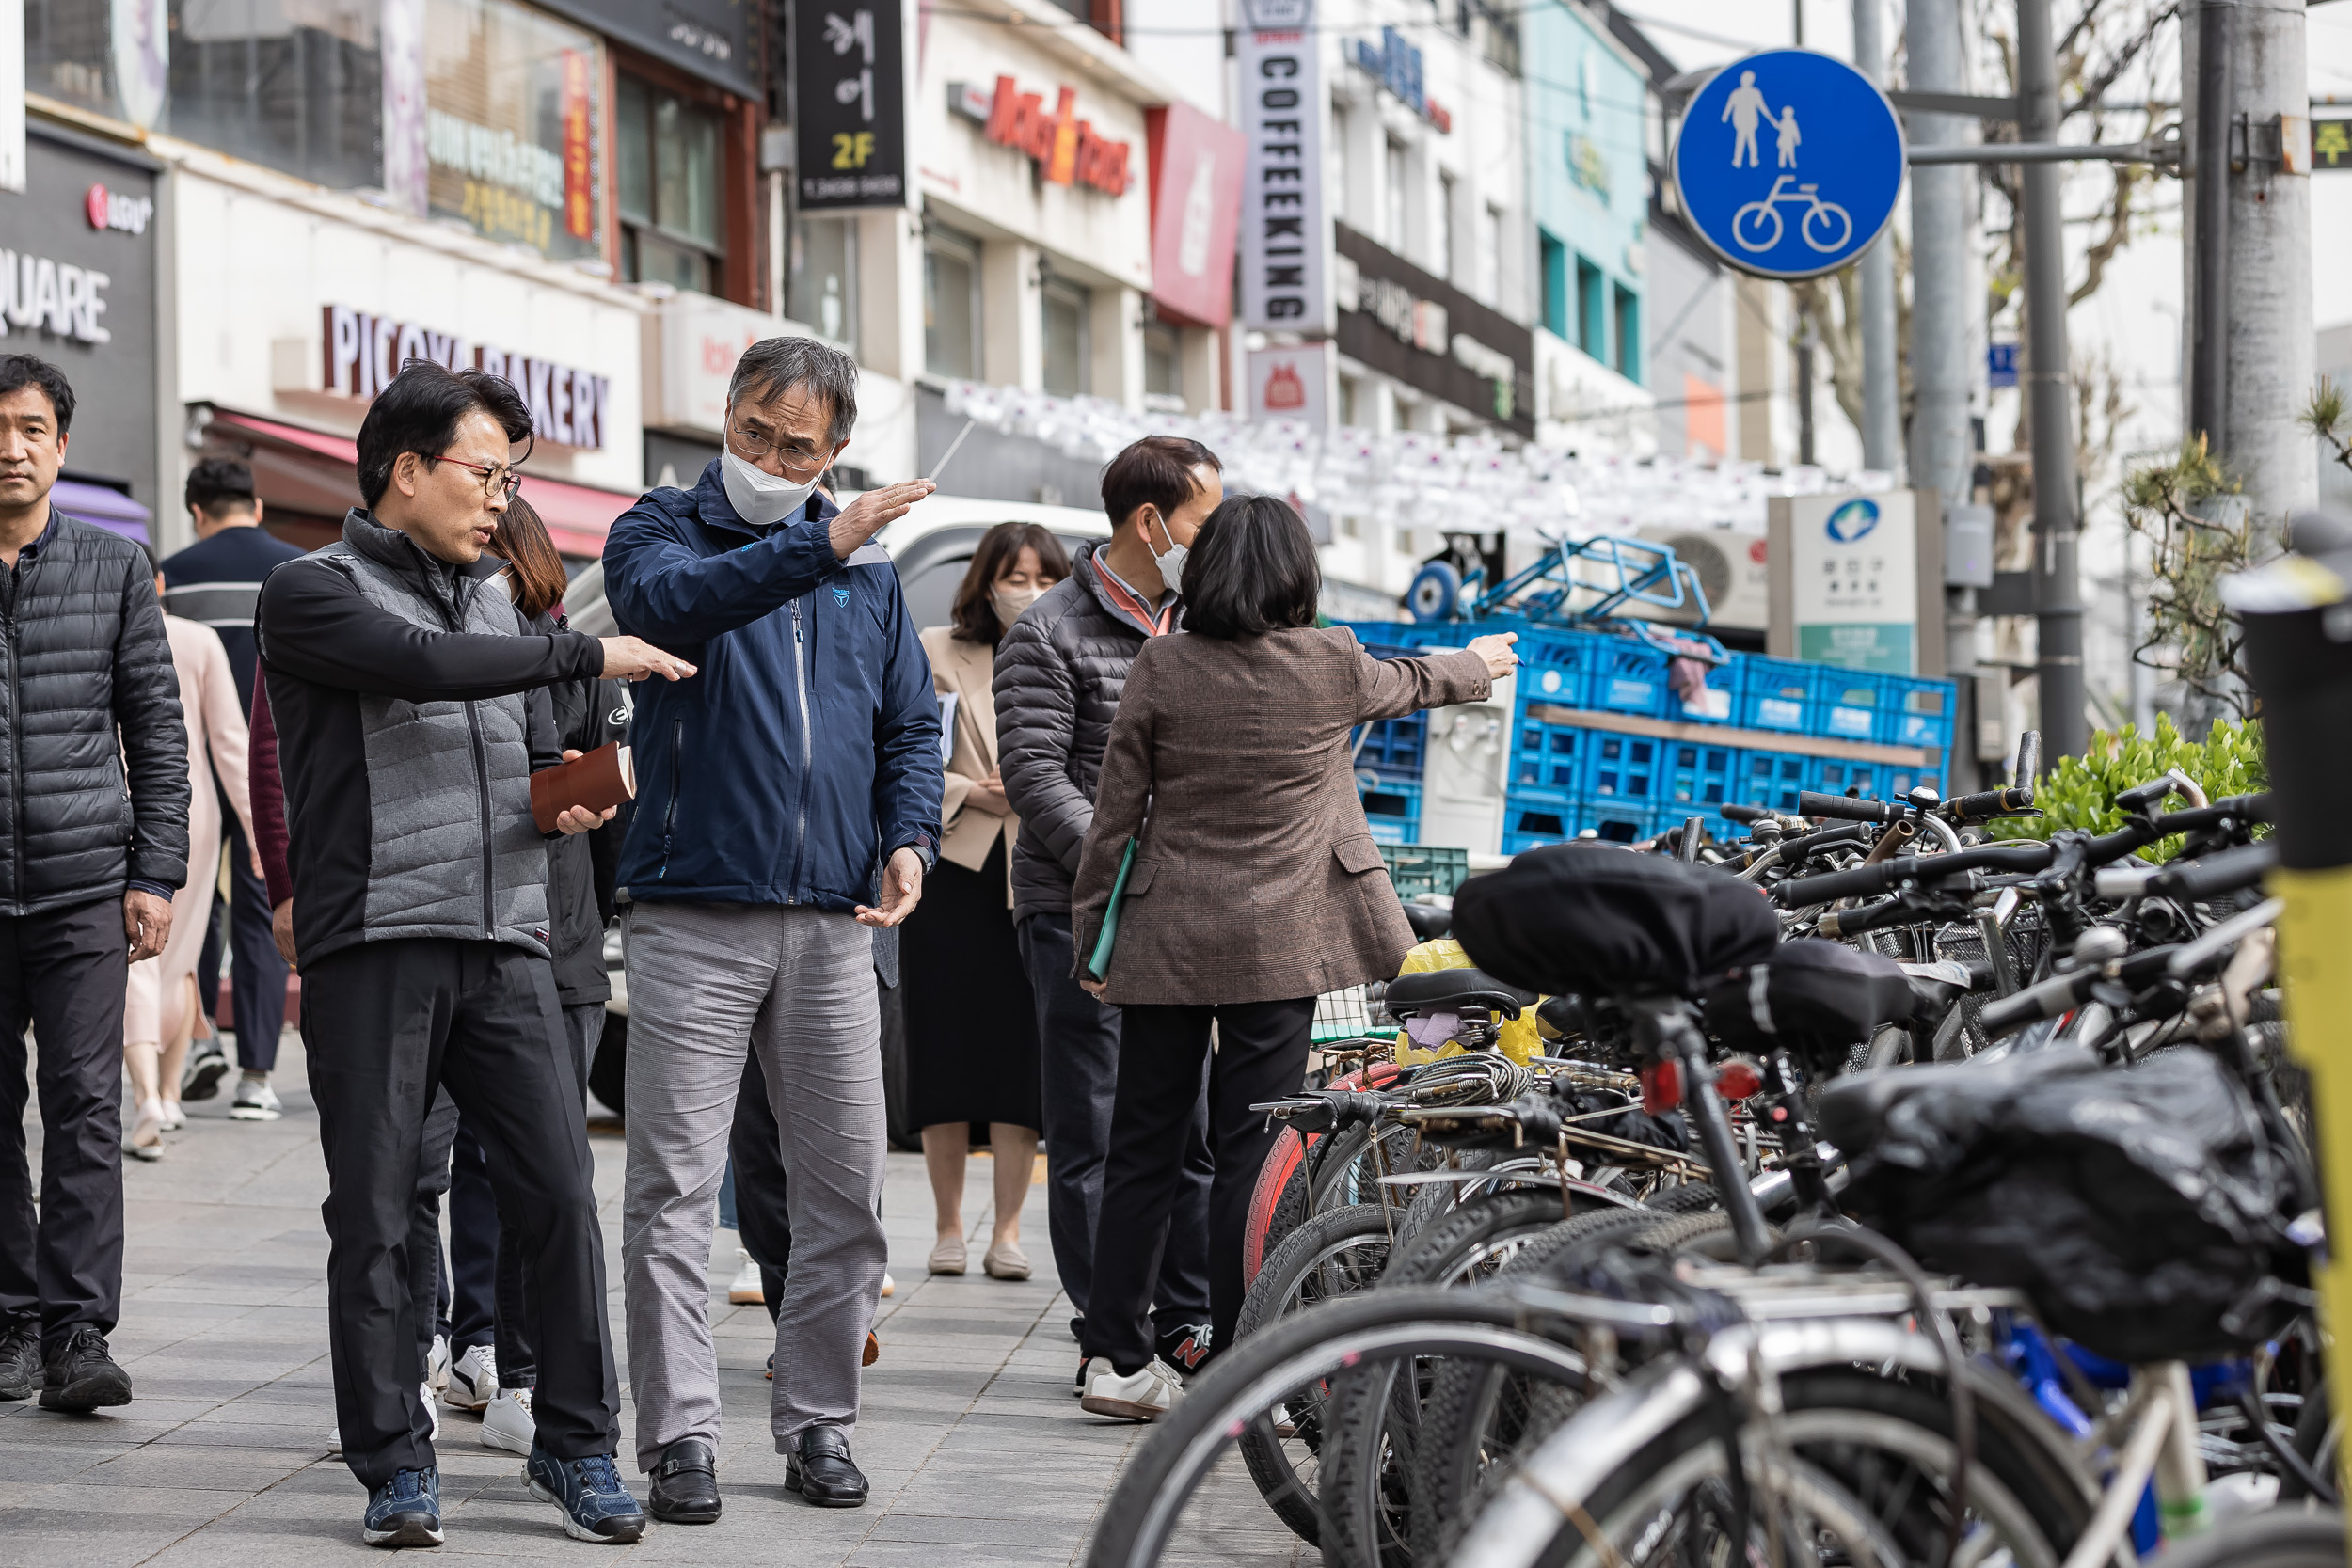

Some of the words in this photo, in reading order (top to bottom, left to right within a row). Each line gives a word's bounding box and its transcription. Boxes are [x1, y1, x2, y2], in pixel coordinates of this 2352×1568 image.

[831, 132, 875, 169] 2F
[1261, 56, 1307, 322] COFFEEKING
[1172, 1337, 1210, 1370] N
